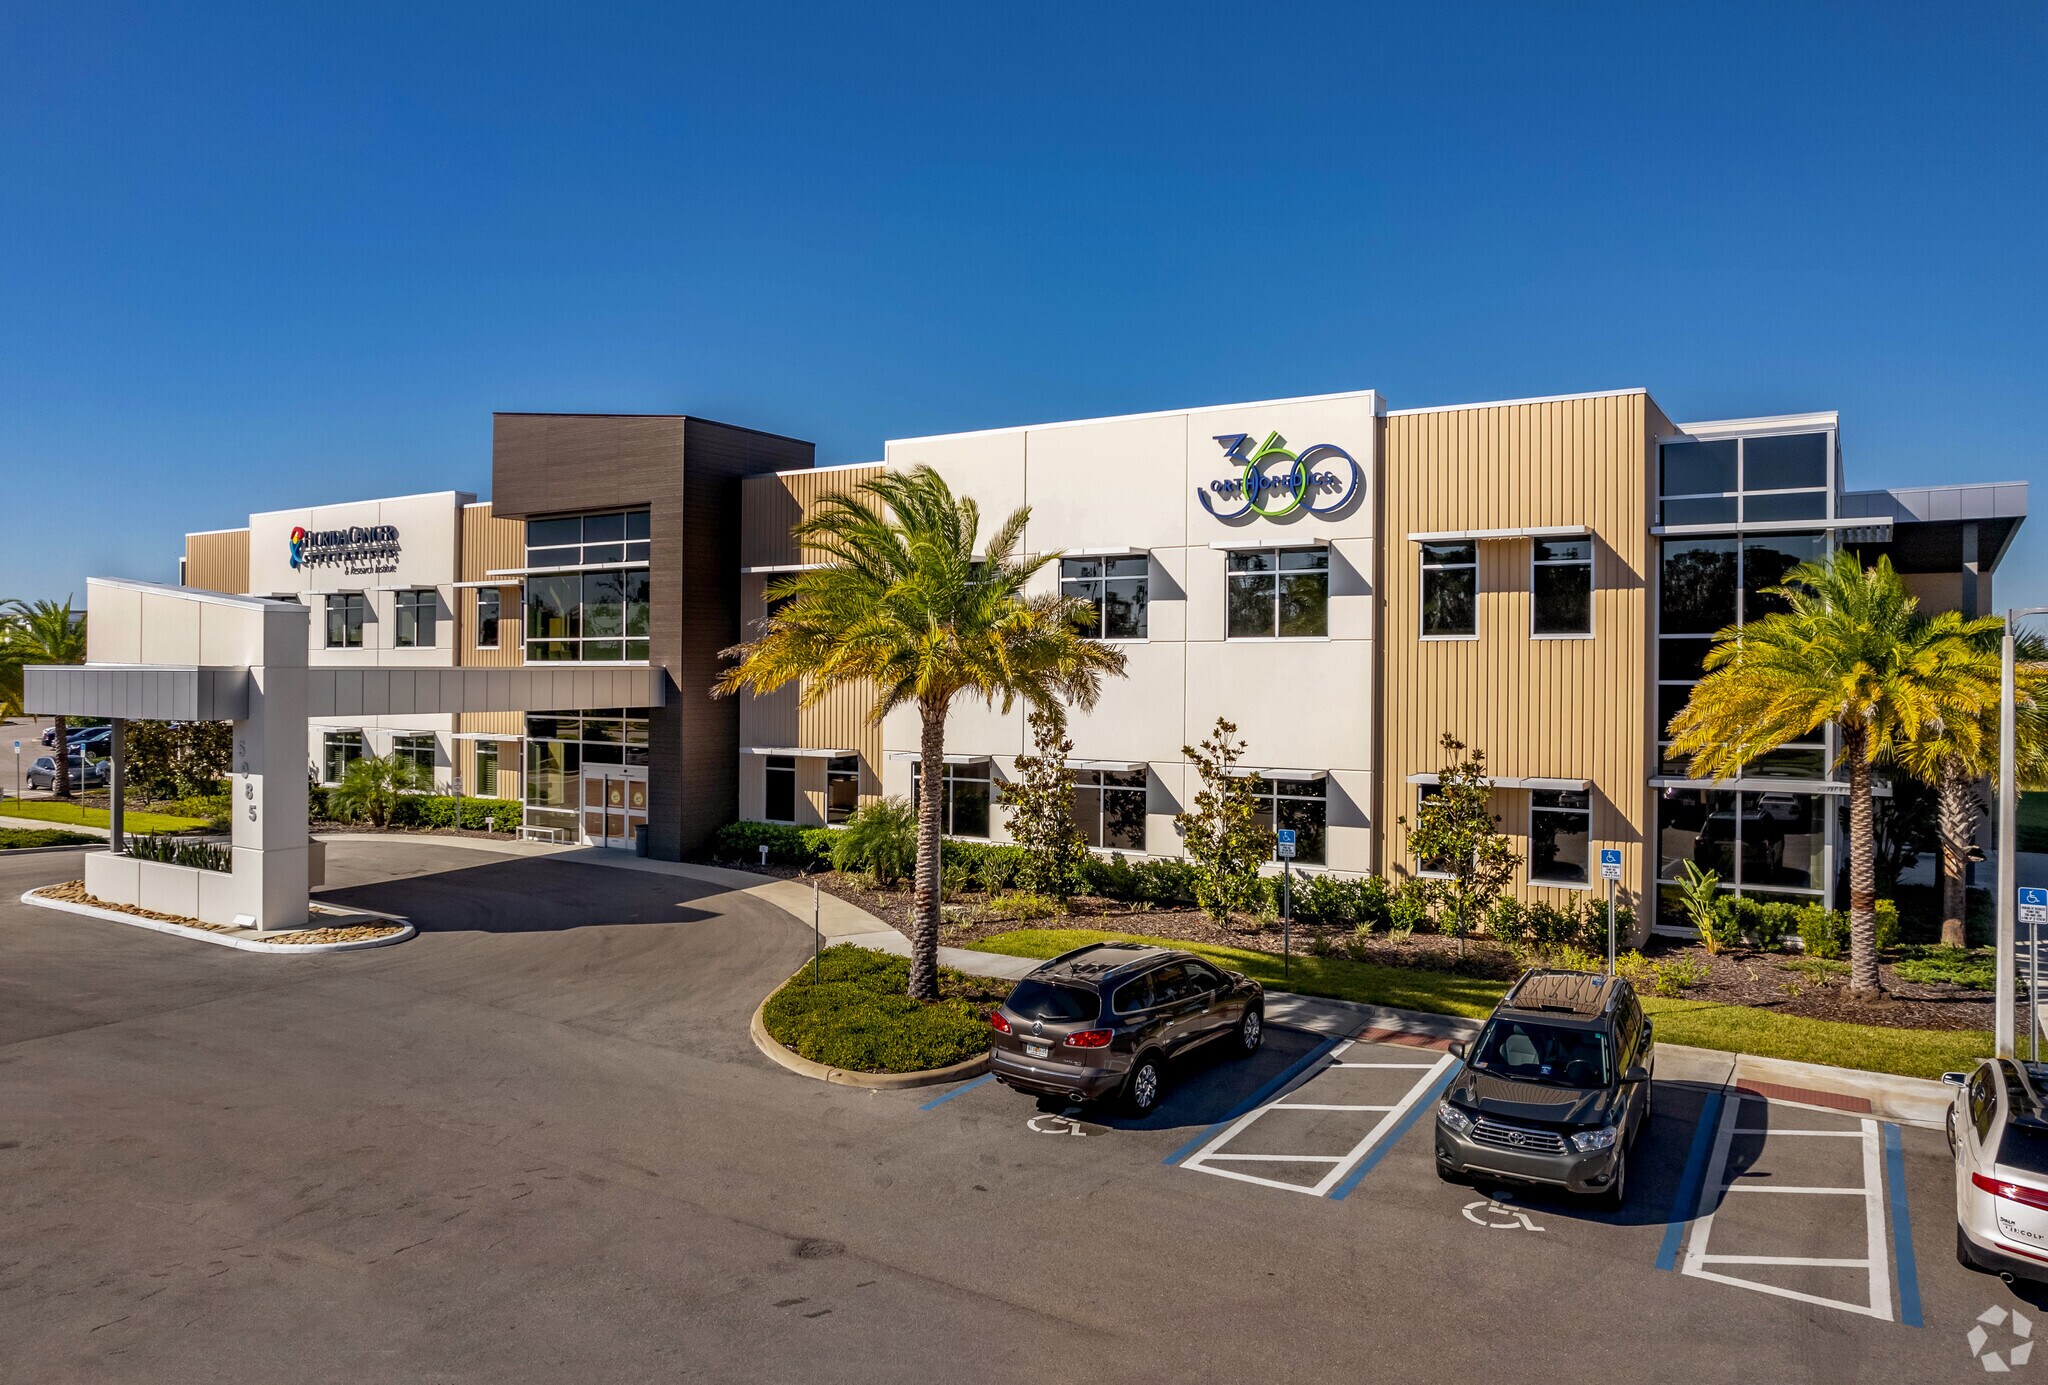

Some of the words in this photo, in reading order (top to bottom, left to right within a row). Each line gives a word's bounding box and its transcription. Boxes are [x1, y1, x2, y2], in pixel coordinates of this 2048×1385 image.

[1197, 430, 1358, 519] 360
[1210, 470, 1334, 493] ORTHOPEDICS
[350, 566, 374, 575] Research
[375, 564, 397, 573] Institute
[239, 741, 257, 822] 5085
